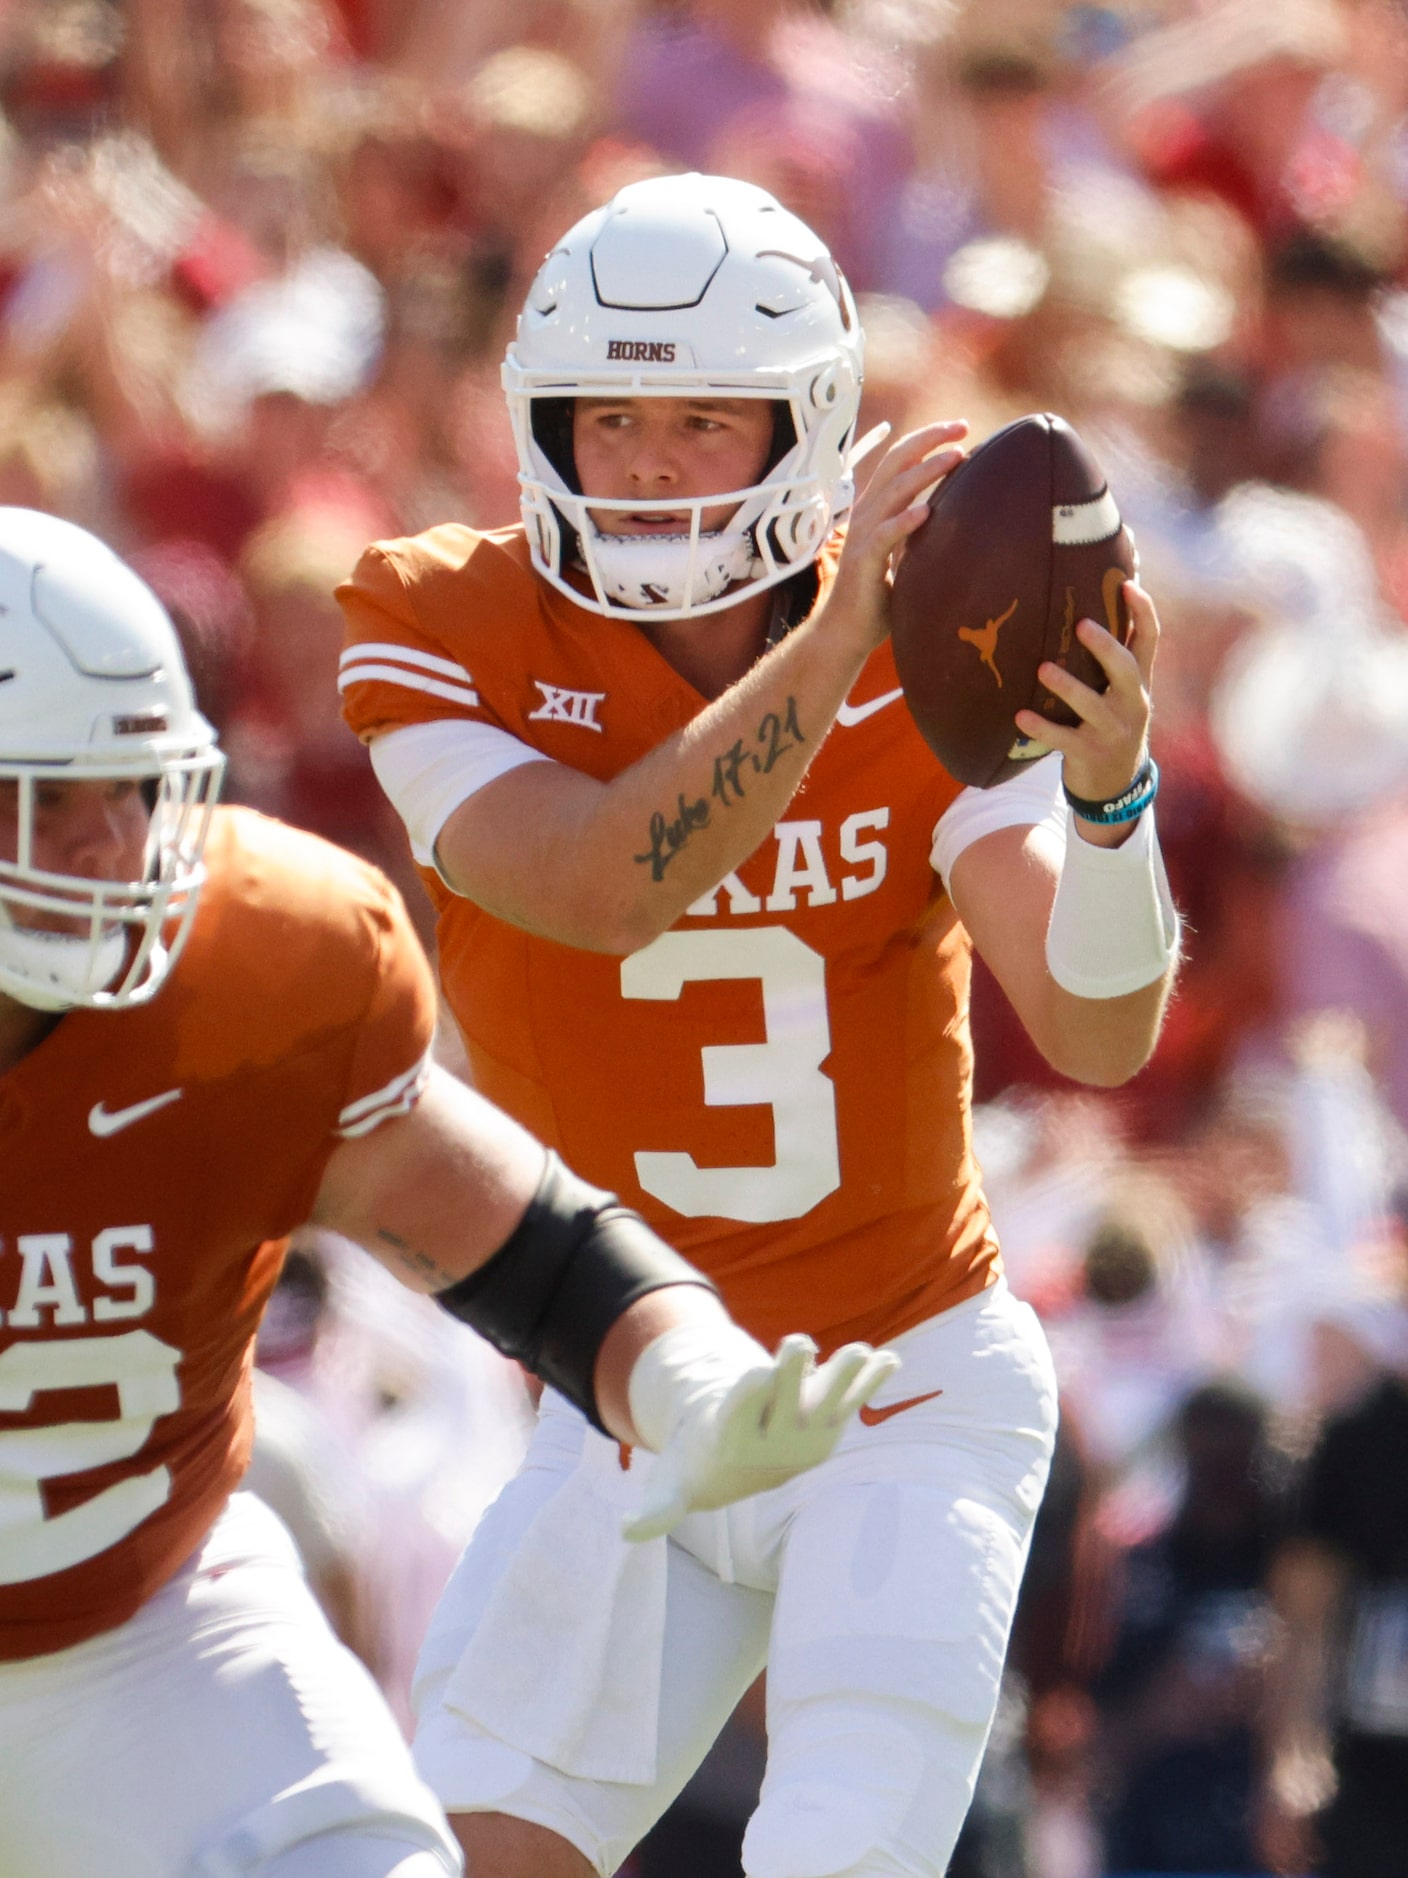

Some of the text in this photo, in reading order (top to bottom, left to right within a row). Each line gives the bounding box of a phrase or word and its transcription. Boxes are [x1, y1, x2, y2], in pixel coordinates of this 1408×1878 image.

[606, 340, 676, 362] HORNS
[528, 680, 606, 734] XII
[634, 793, 711, 881] Luke
[620, 926, 841, 1223] 3
